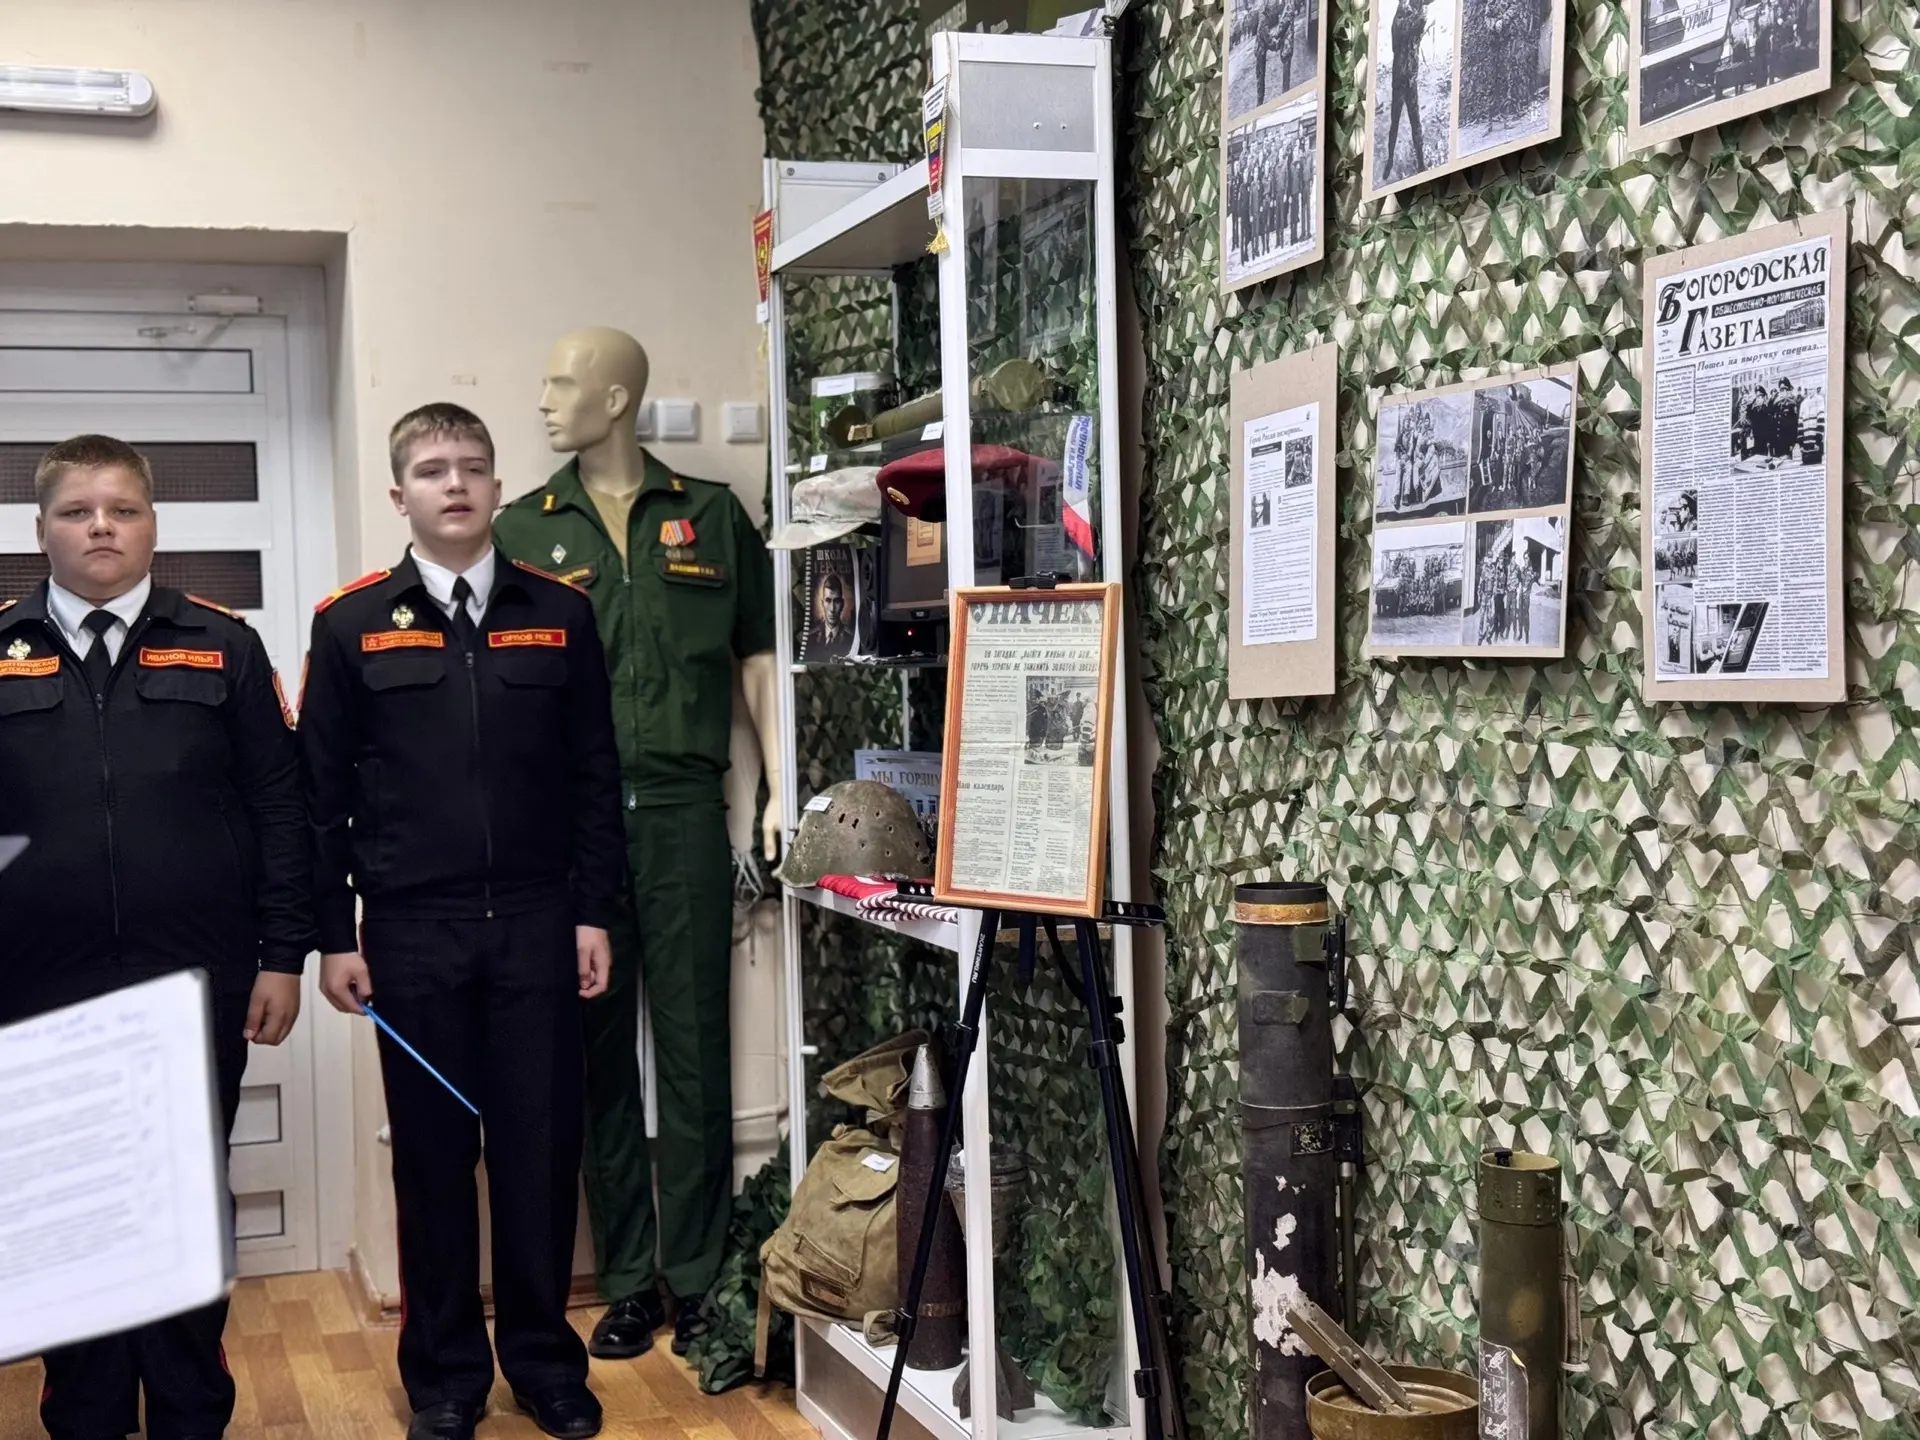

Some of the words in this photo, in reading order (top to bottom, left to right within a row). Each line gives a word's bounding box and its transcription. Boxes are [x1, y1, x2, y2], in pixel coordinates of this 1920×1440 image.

[1656, 247, 1827, 327] БОГОРОДСКАЯ
[1678, 305, 1767, 356] ГАЗЕТА
[1697, 360, 1725, 371] Пошел
[1728, 357, 1738, 366] на
[1741, 349, 1779, 363] выручку
[816, 549, 848, 561] ШКОЛА
[146, 653, 186, 661] ИВАНОВ
[187, 654, 214, 663] ИЛЬЯ
[871, 771, 894, 784] МЫ
